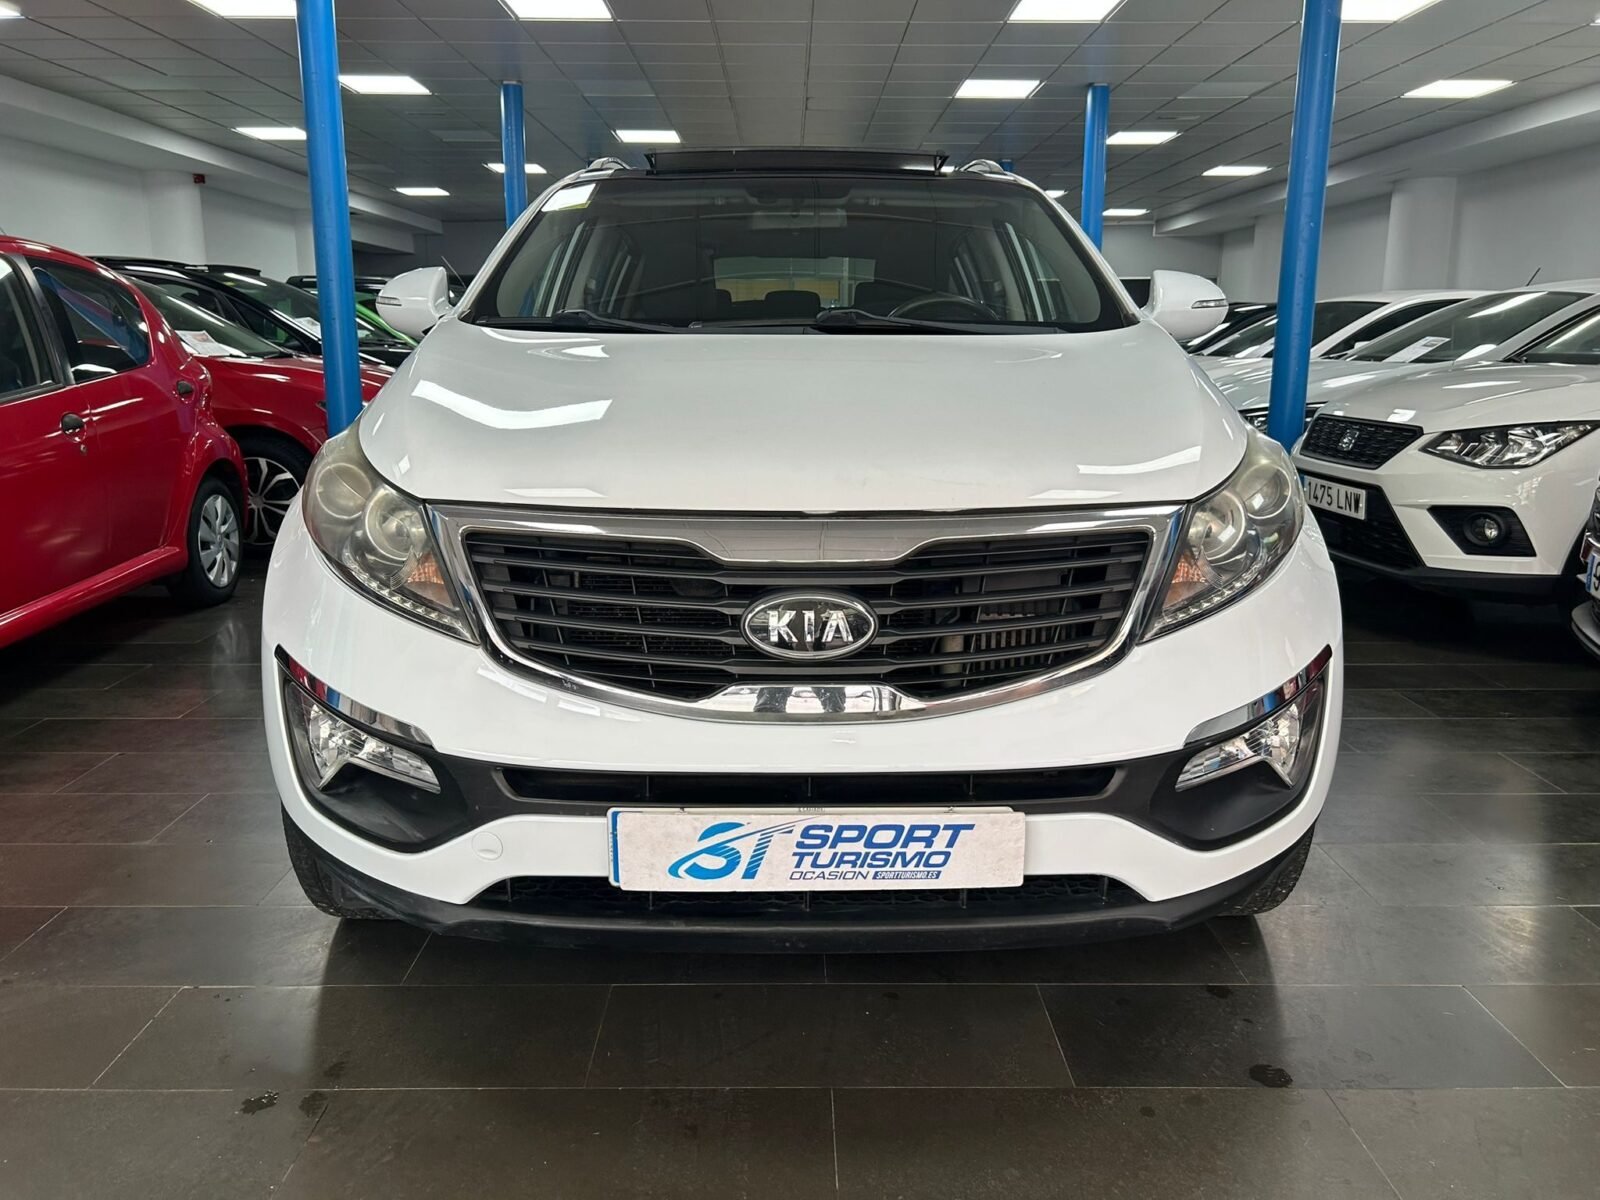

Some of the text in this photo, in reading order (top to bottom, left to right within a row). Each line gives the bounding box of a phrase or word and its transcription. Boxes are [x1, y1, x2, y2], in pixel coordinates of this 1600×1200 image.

[1308, 481, 1361, 514] 1475 LNW
[767, 610, 854, 643] KIA
[795, 823, 976, 850] SPORT
[791, 850, 953, 869] TURISMO
[789, 870, 939, 881] OCASION SPORTTURISMO.ES
